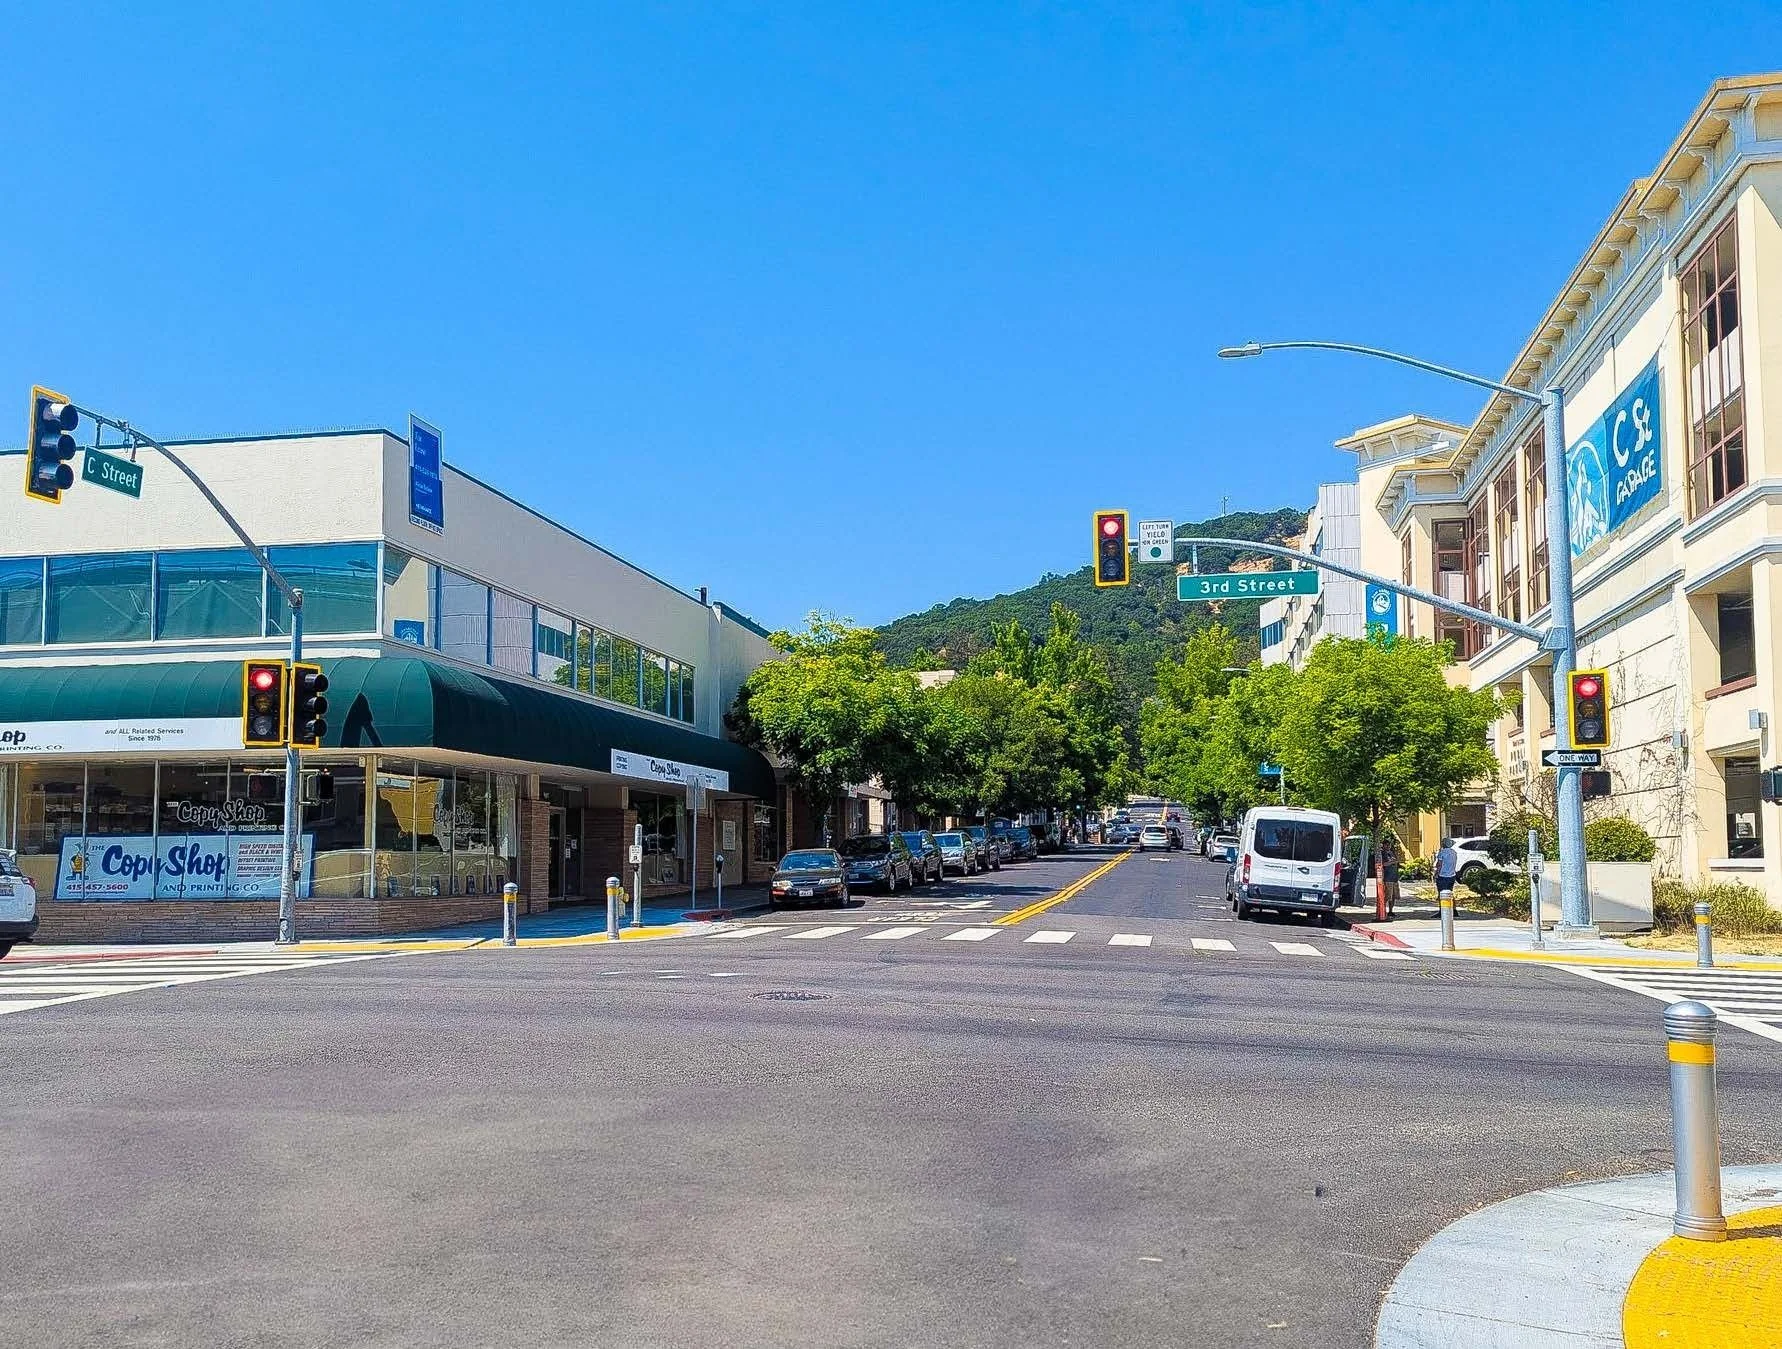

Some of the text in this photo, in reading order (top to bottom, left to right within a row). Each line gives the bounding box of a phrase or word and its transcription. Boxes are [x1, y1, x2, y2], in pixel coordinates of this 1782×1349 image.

[1613, 398, 1653, 467] C St
[87, 456, 137, 488] C Street
[1616, 449, 1657, 505] GARAGE
[1200, 577, 1295, 594] 3rd Street
[650, 760, 666, 777] Copy
[666, 763, 681, 777] Shop
[1559, 754, 1595, 762] ONE WAY
[177, 799, 266, 828] Copy Shop
[102, 843, 230, 886] Copy Shop
[162, 884, 187, 892] AND
[190, 884, 240, 892] PRINTING
